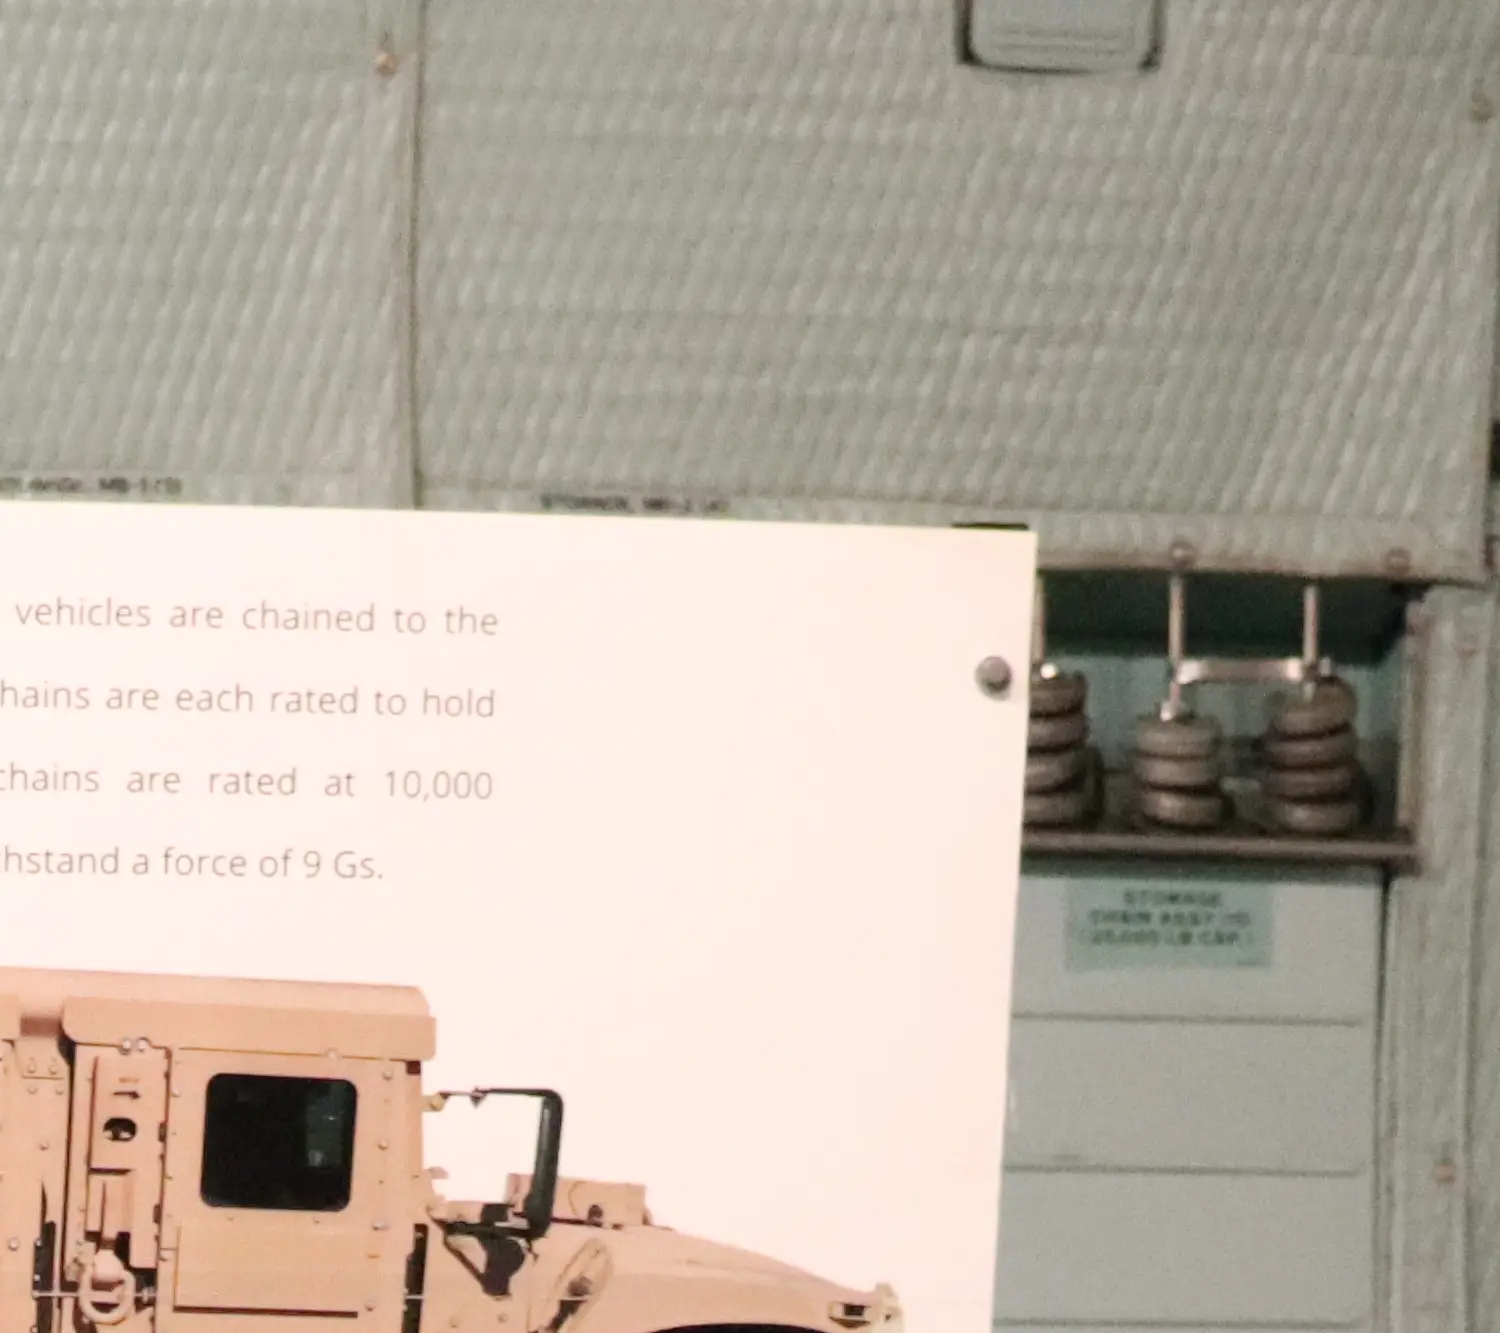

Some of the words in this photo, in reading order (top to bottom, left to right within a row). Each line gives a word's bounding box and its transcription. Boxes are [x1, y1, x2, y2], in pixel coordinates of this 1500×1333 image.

[14, 595, 152, 629] vehicles
[168, 605, 225, 630] are
[241, 599, 376, 633] chained
[393, 608, 428, 635] to
[444, 605, 499, 637] the
[104, 687, 161, 712] are
[174, 682, 254, 713] each
[270, 685, 360, 716] rated
[373, 689, 408, 716] to
[422, 687, 496, 719] hold
[125, 770, 182, 795] are
[208, 765, 298, 797] rated
[323, 772, 356, 798] at
[384, 769, 493, 803] 10,000
[130, 853, 150, 877] a
[161, 845, 248, 878] force
[258, 847, 294, 878] of
[302, 849, 323, 879] 9
[332, 849, 384, 880] Gs.
